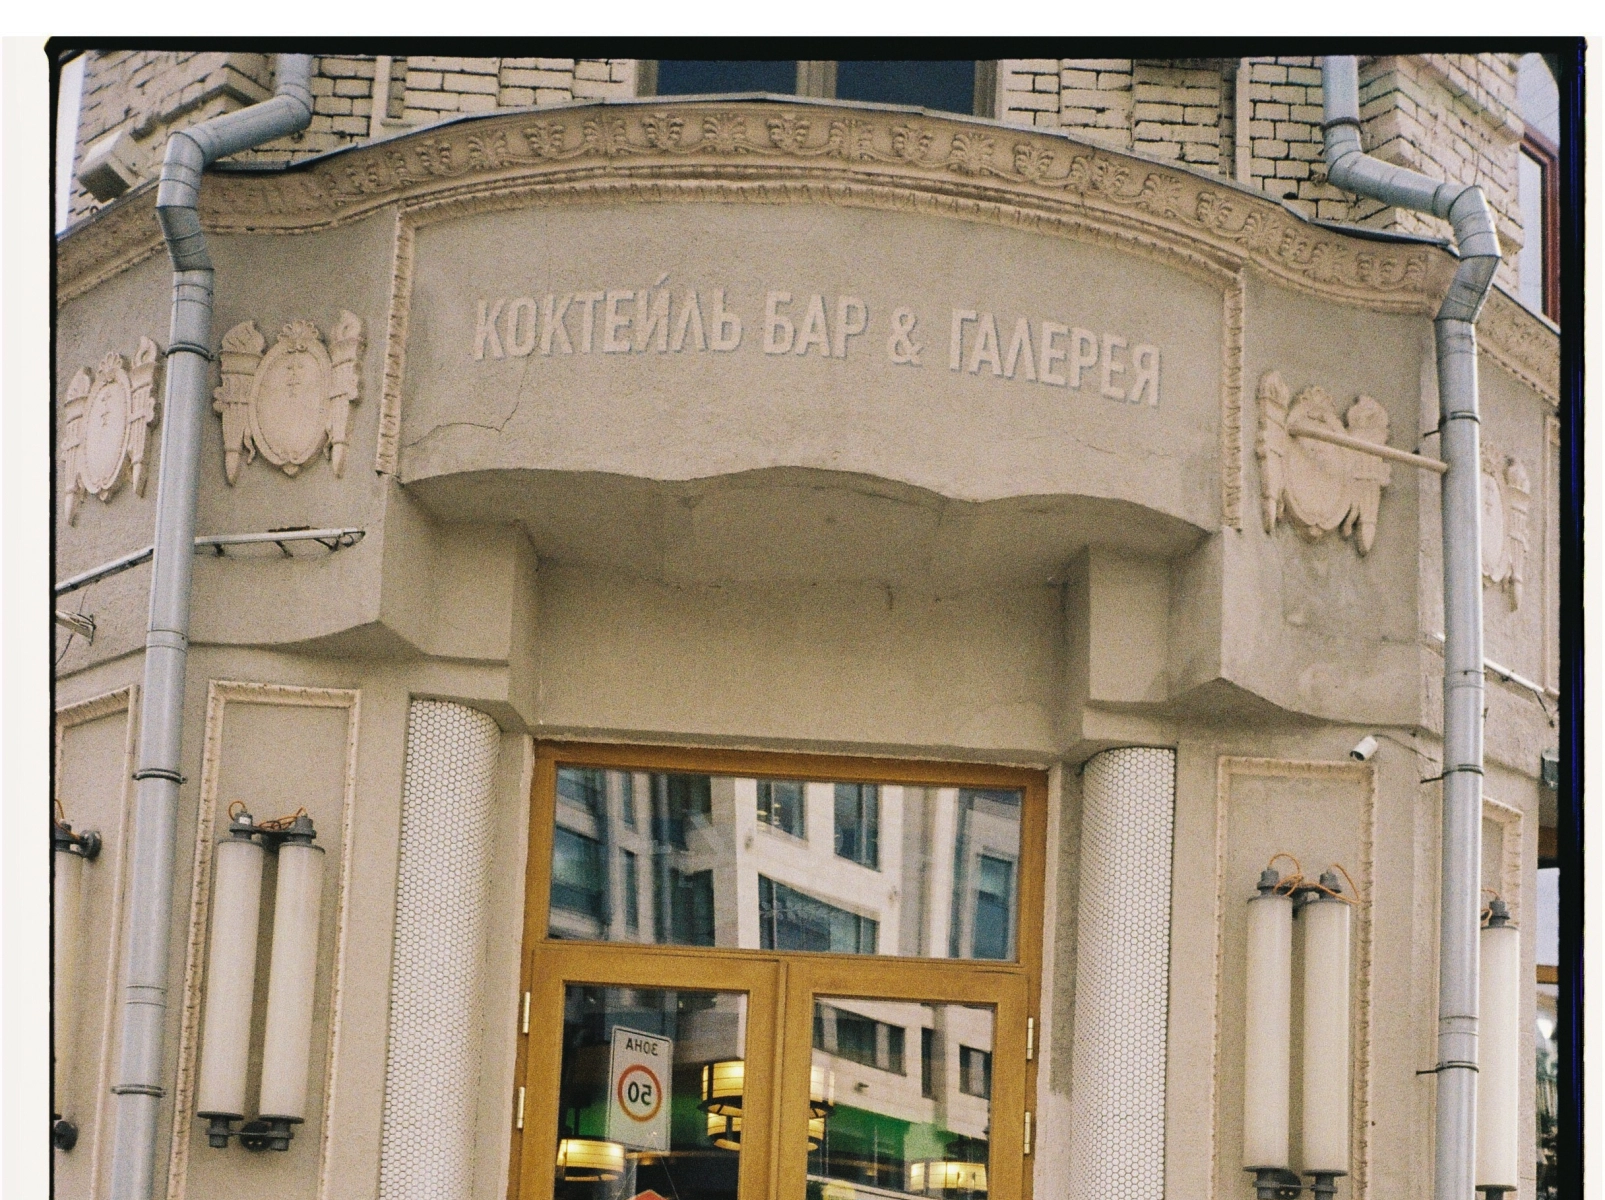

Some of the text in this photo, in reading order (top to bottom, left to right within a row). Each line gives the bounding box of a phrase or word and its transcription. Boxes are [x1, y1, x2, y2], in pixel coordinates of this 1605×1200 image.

[475, 273, 1161, 407] КОКТЕЙЛЬ БАР & ГАЛЕРЕЯ
